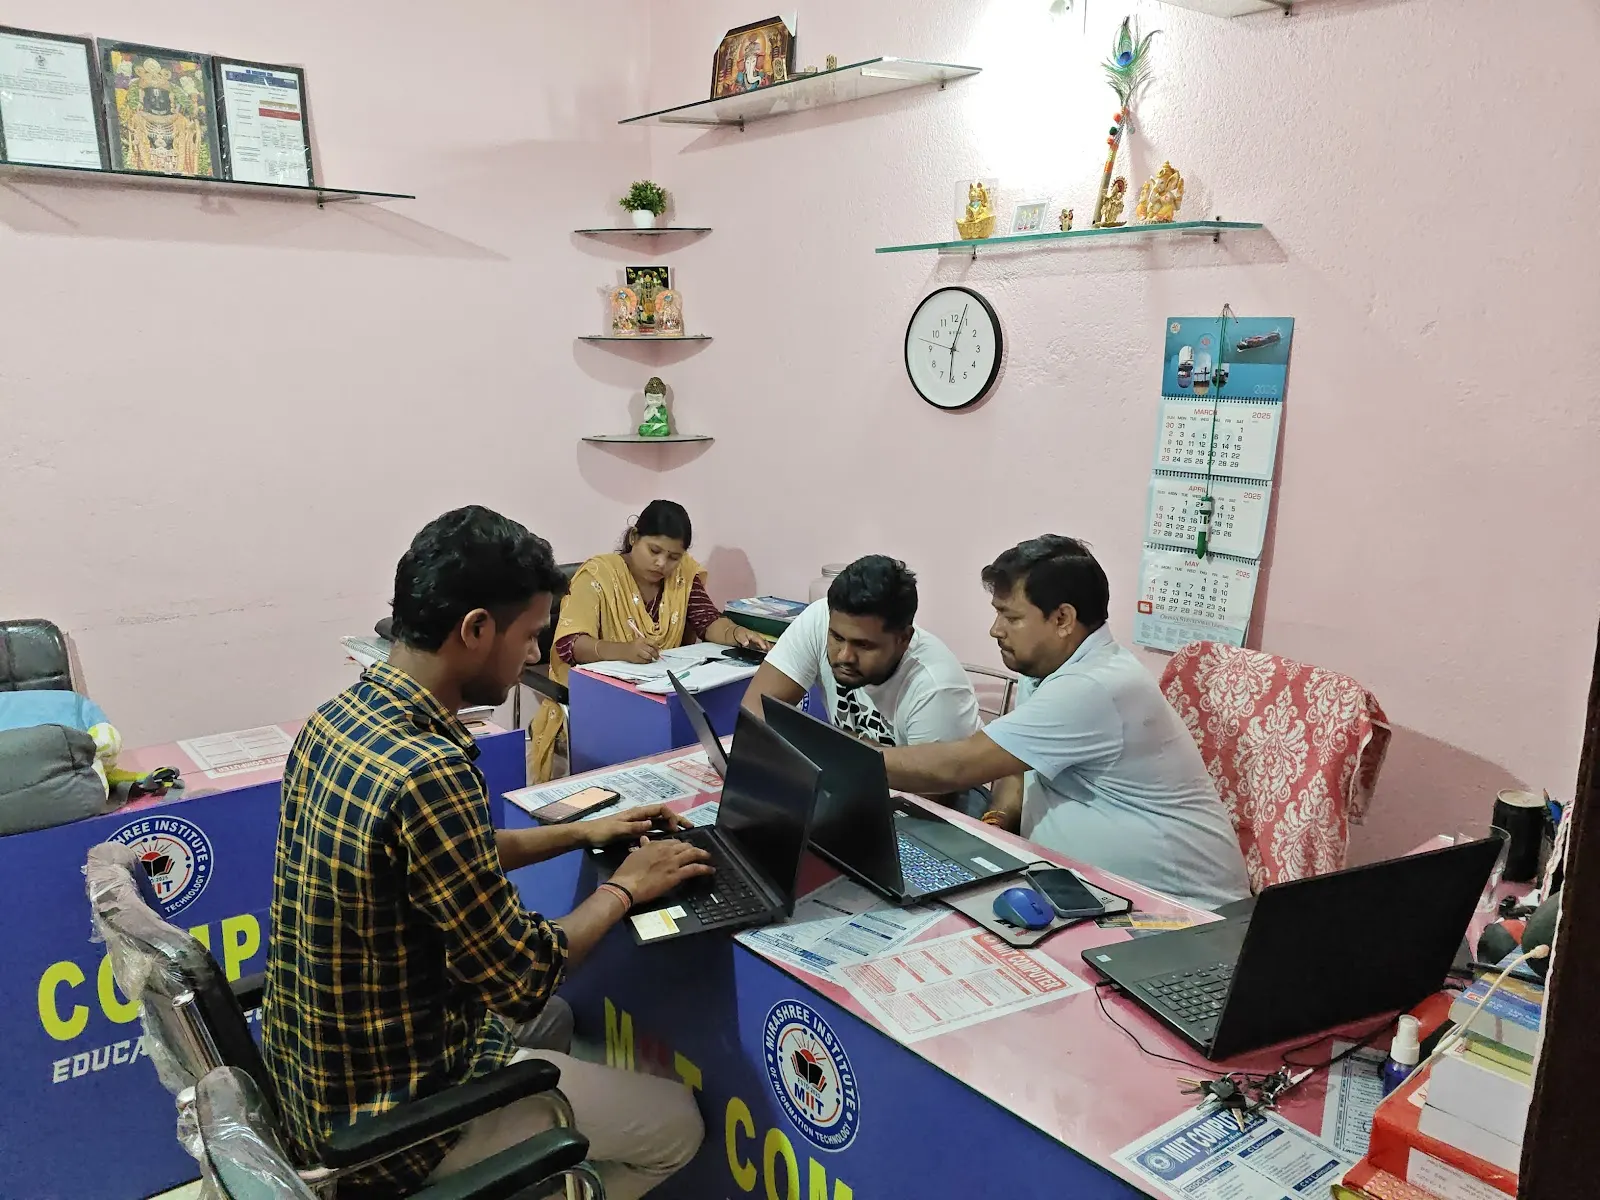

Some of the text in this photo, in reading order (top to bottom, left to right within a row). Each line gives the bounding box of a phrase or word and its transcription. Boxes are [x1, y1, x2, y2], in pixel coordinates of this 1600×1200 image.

[1236, 570, 1250, 578] 2025
[113, 820, 208, 862] HREE INSTITUTE
[157, 880, 173, 894] IT
[164, 874, 204, 912] TECHNOLOGY
[1008, 955, 1062, 990] COMPUTER
[766, 1005, 856, 1110] MIRASHREE INSTITUTE
[770, 1066, 852, 1145] OF INFORMATION TECHNOLOGY
[795, 1083, 824, 1116] MIIT
[1160, 1136, 1200, 1163] MIIT
[1186, 1108, 1250, 1147] COMPUT
